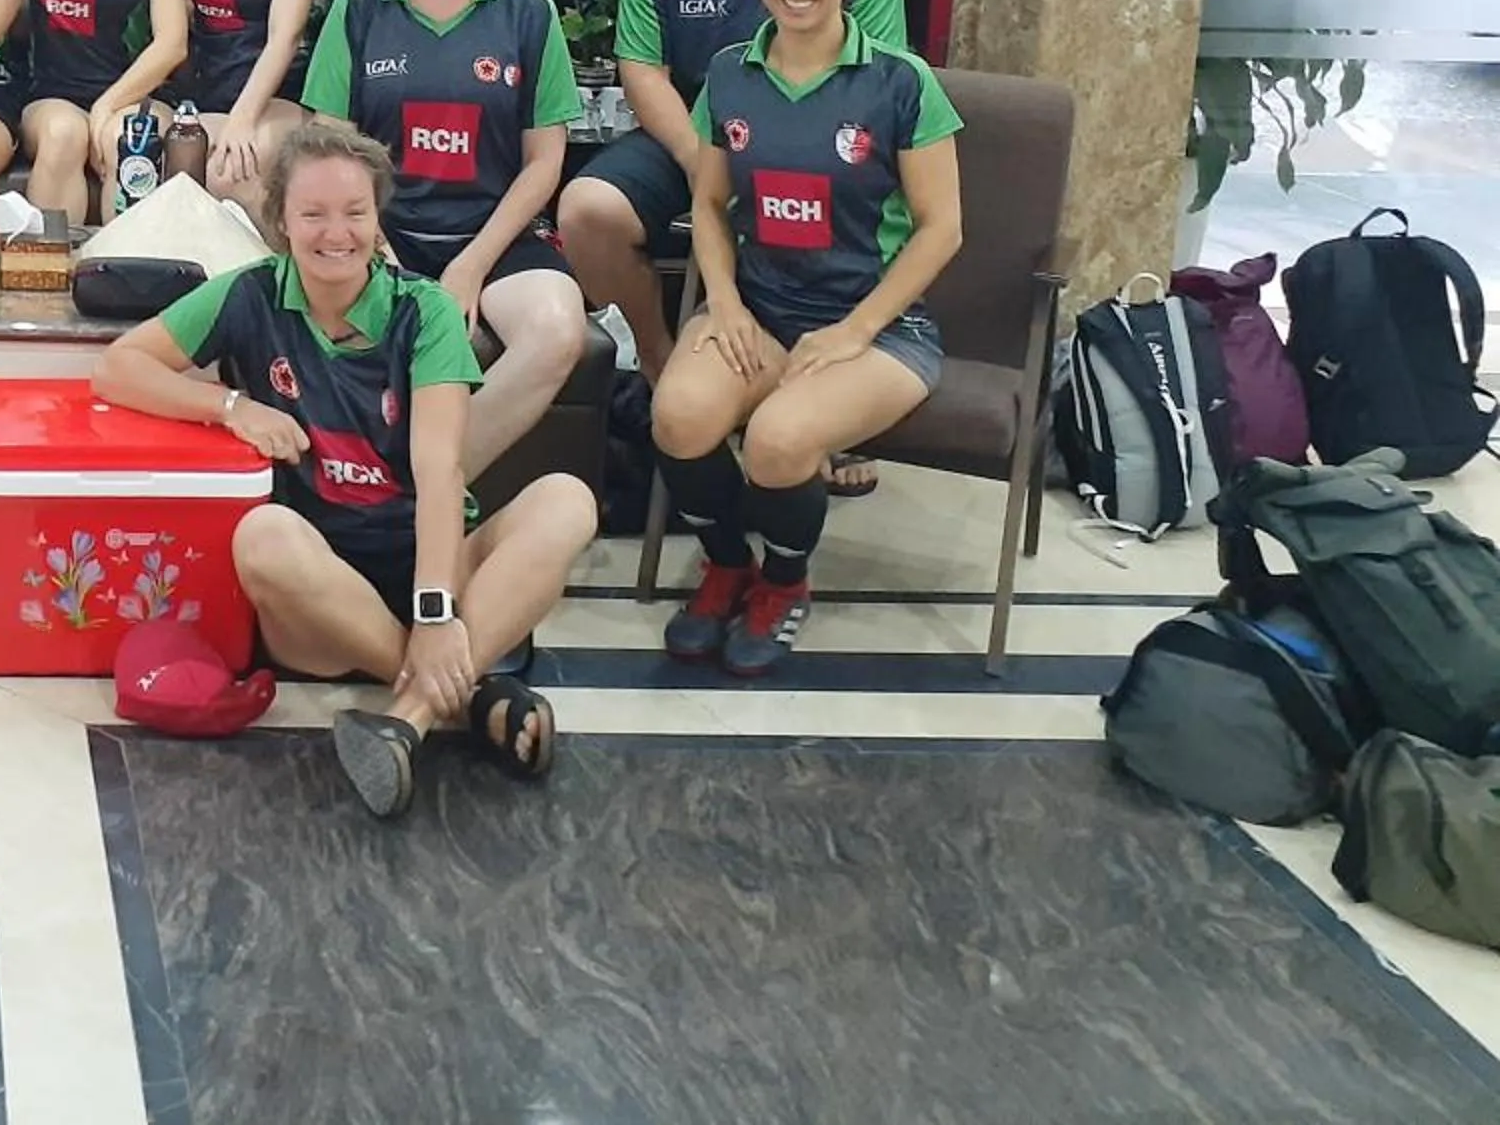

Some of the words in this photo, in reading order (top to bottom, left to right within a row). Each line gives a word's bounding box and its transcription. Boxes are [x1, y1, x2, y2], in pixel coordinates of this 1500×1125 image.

[411, 127, 469, 154] RCH
[762, 195, 822, 222] RCH
[321, 458, 388, 485] RCH
